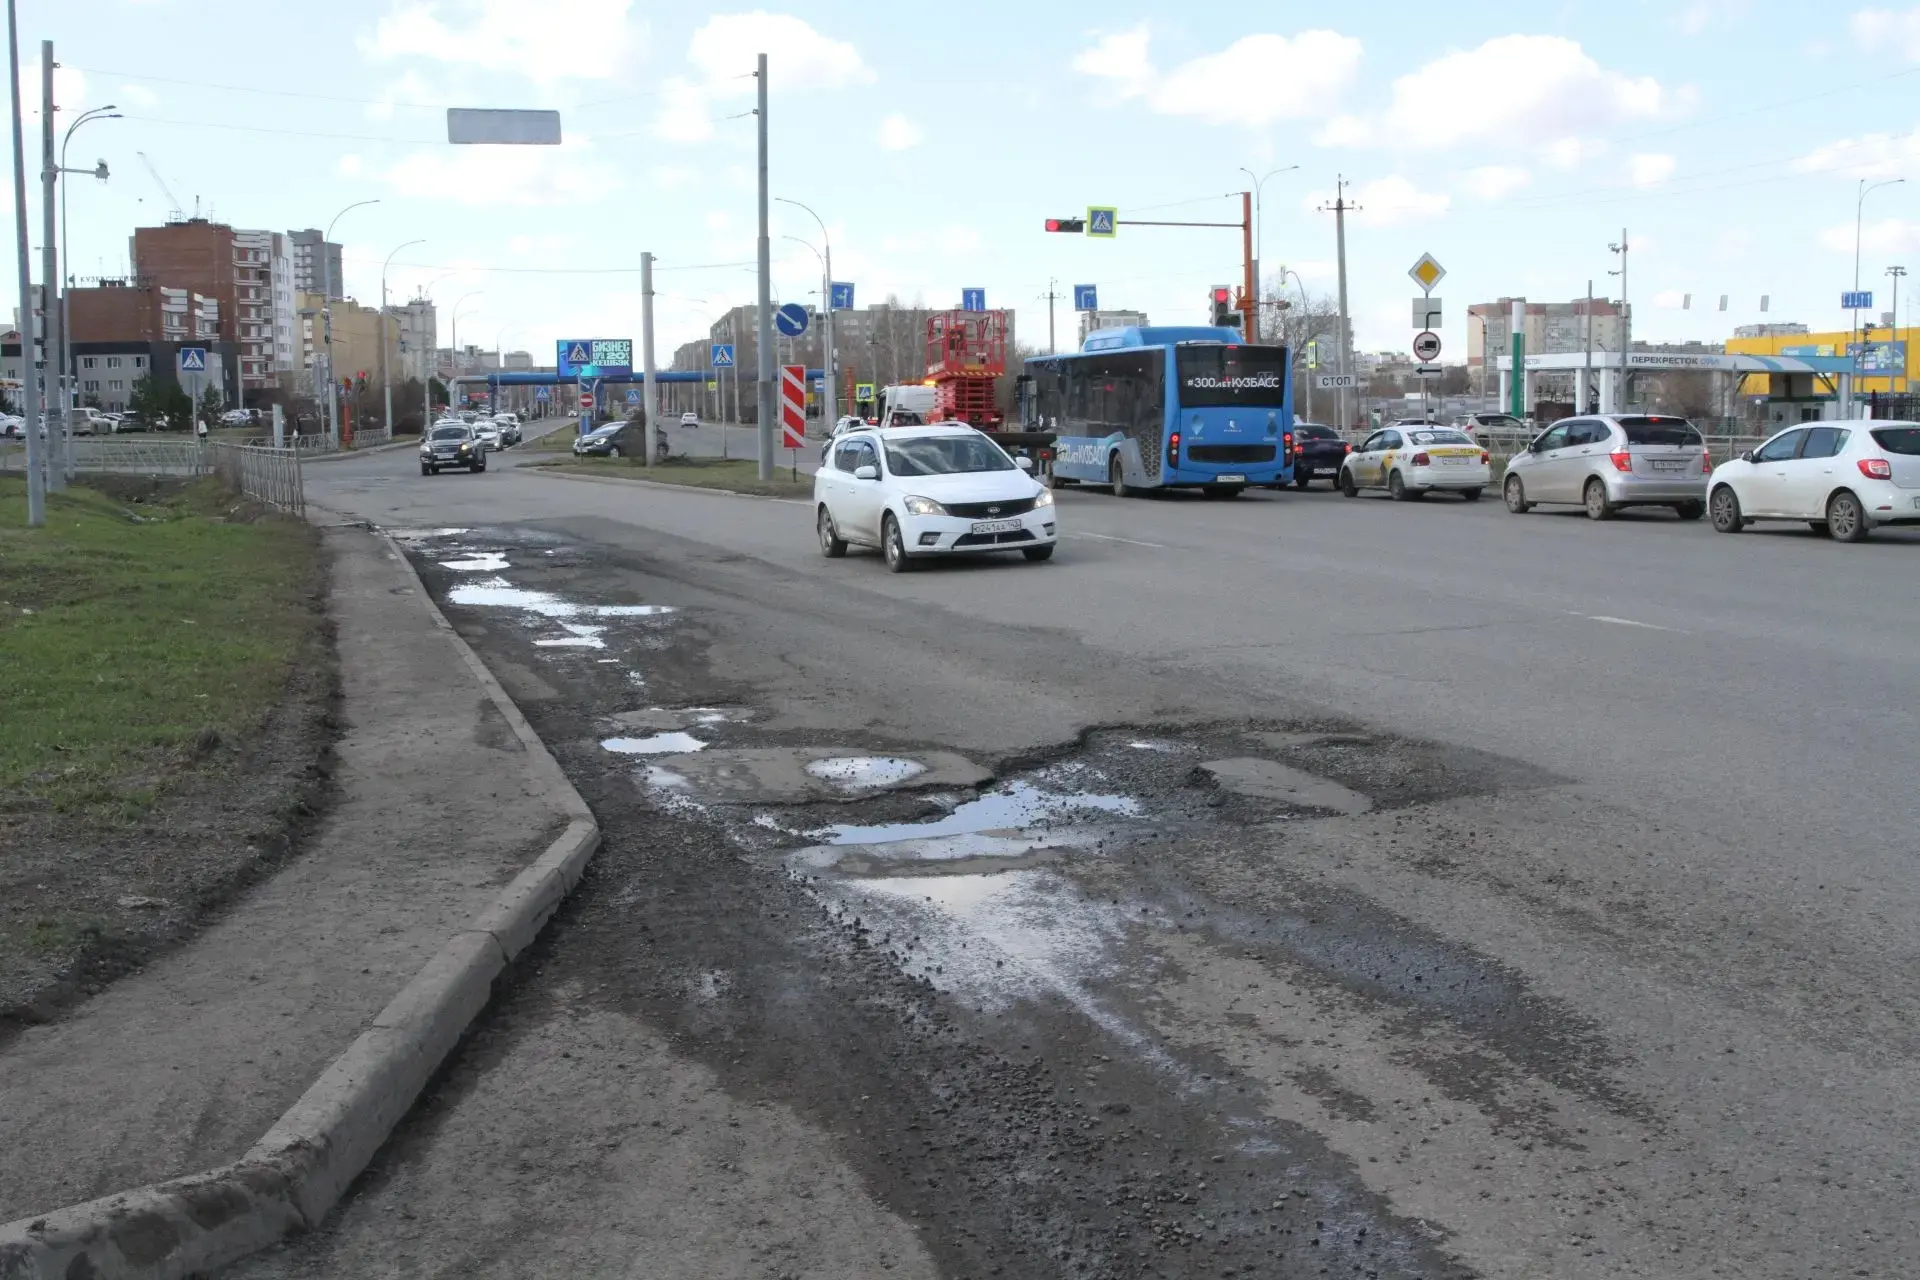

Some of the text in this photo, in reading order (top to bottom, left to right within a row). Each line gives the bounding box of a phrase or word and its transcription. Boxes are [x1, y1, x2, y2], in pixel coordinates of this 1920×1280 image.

[592, 341, 630, 352] БИЗНЕС
[1631, 356, 1698, 365] ПЕРЕКРЕСТОК
[1322, 376, 1351, 386] СТОП
